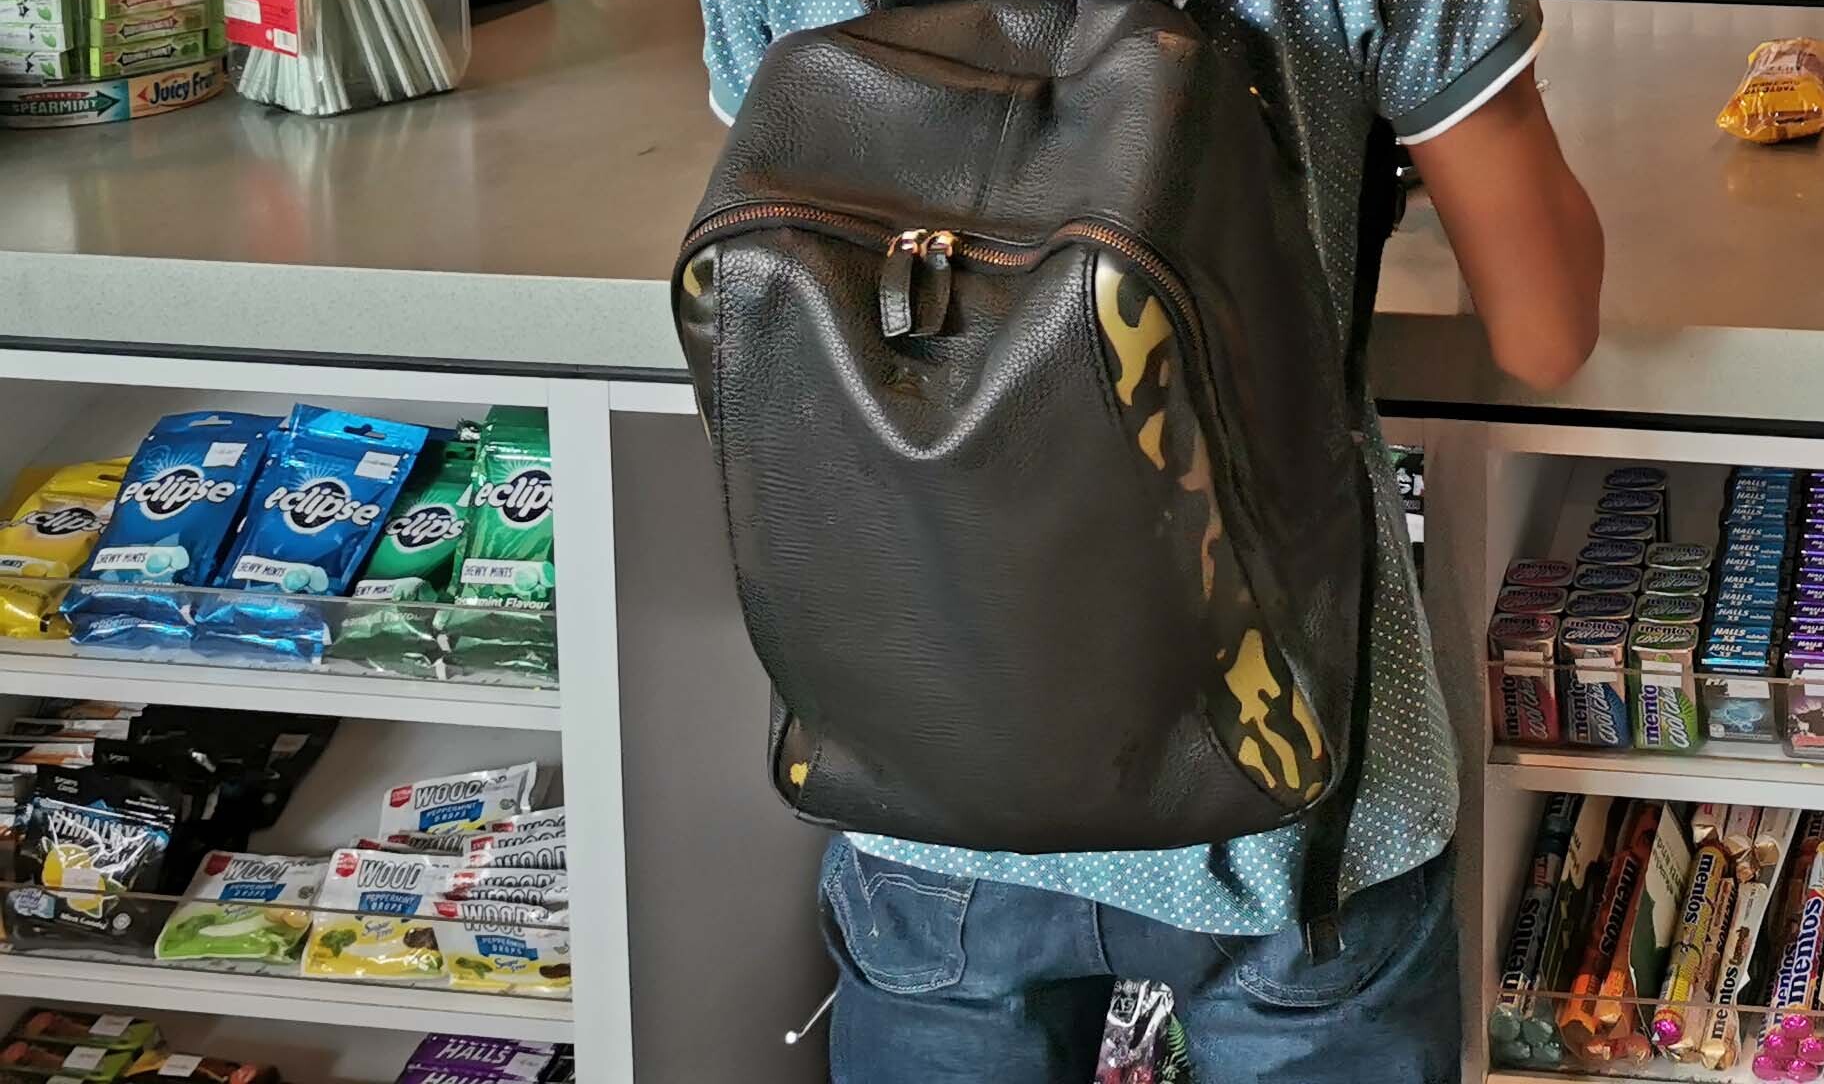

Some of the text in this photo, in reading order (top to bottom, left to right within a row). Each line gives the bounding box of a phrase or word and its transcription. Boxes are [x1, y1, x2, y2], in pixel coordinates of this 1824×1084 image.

[150, 77, 191, 106] Juicy
[120, 475, 236, 510] eclipse
[264, 485, 381, 527] eclipse
[1730, 544, 1760, 553] HALLS
[1724, 576, 1754, 585] HALLS
[505, 598, 550, 611] Flavour
[1718, 607, 1750, 616] HALLS
[1569, 620, 1624, 630] mentos
[1640, 625, 1692, 635] mentos
[1714, 627, 1746, 637] HALLS
[1709, 643, 1742, 653] HALLS
[425, 803, 478, 820] PEPPERMINT
[1685, 853, 1713, 925] mentos
[365, 892, 416, 904] PEPPERMINT
[1788, 897, 1824, 1005] mentos
[435, 1041, 509, 1063] HALLS
